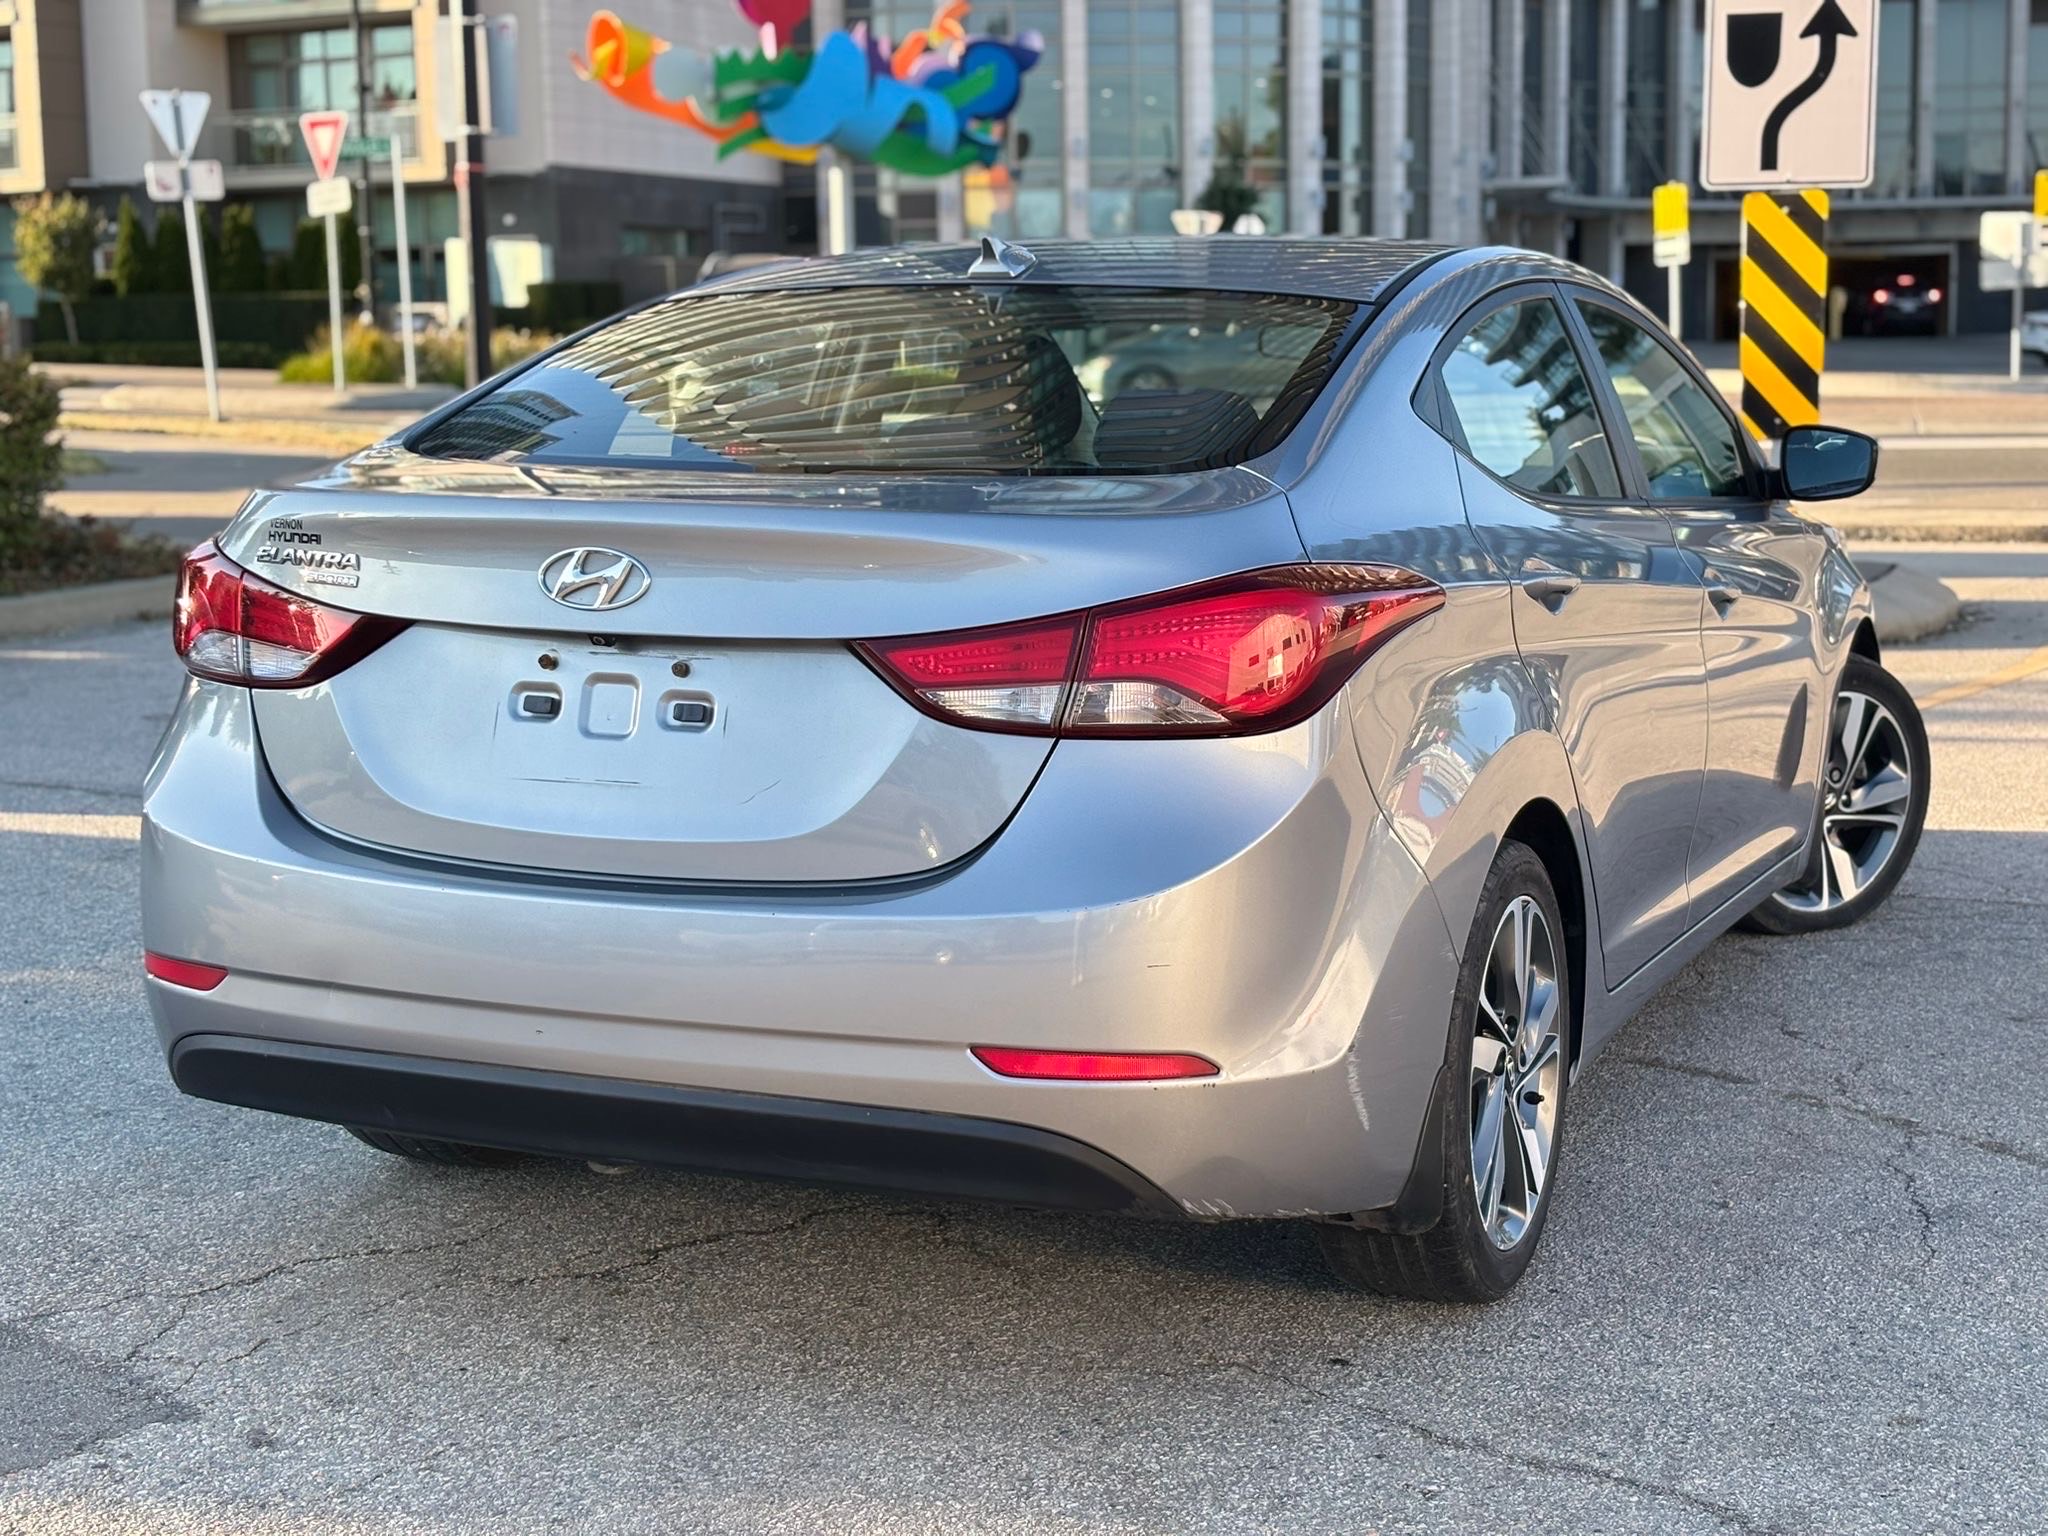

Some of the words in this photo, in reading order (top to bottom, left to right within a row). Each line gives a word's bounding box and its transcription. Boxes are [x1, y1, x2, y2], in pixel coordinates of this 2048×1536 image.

[271, 518, 304, 530] VERNON
[268, 531, 322, 545] HYUNDAI
[256, 545, 361, 571] ELANTRA
